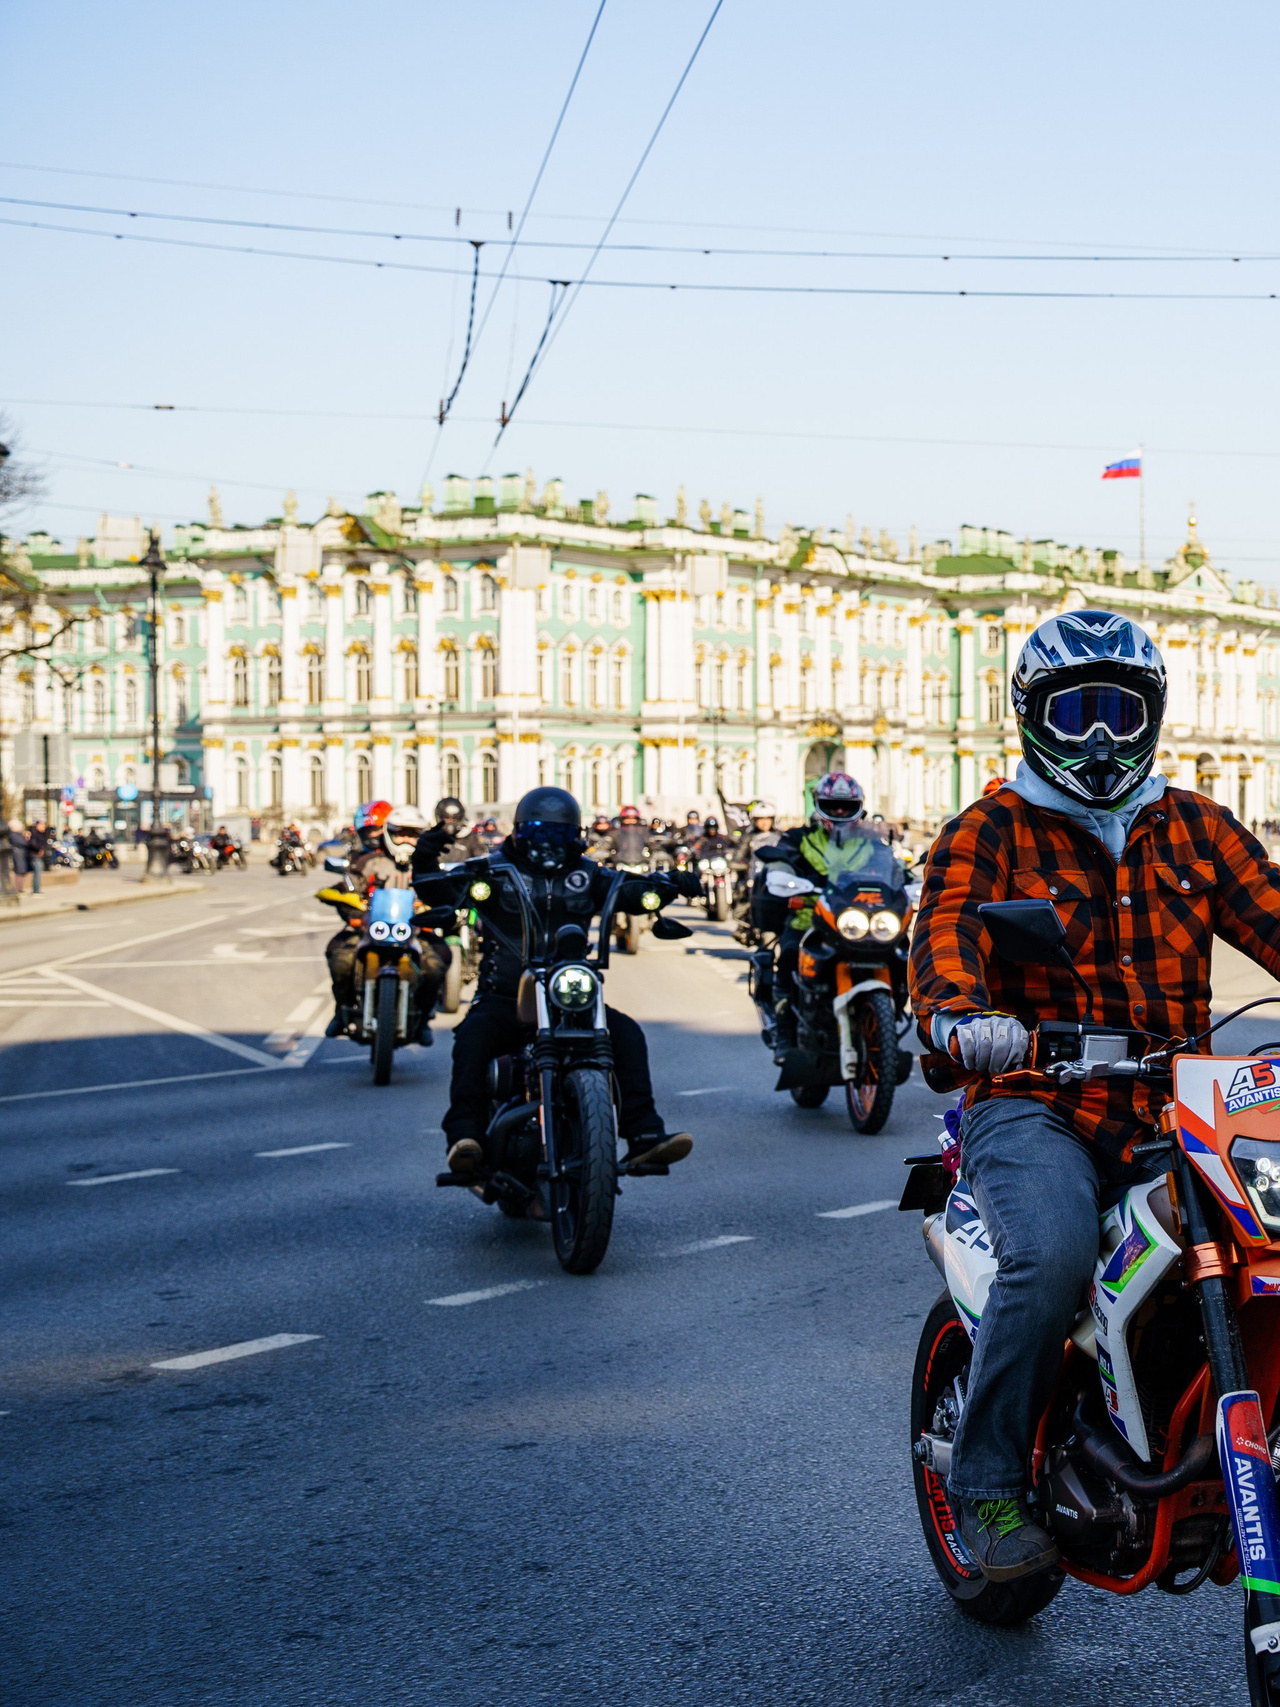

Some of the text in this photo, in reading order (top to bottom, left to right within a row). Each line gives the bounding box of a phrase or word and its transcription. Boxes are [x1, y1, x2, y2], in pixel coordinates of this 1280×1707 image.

[1227, 1061, 1276, 1099] A5
[1244, 1440, 1267, 1455] CHOHO
[1056, 1503, 1079, 1520] AVANTIS
[1234, 1457, 1266, 1561] AVANTIS
[944, 1533, 970, 1565] RACING
